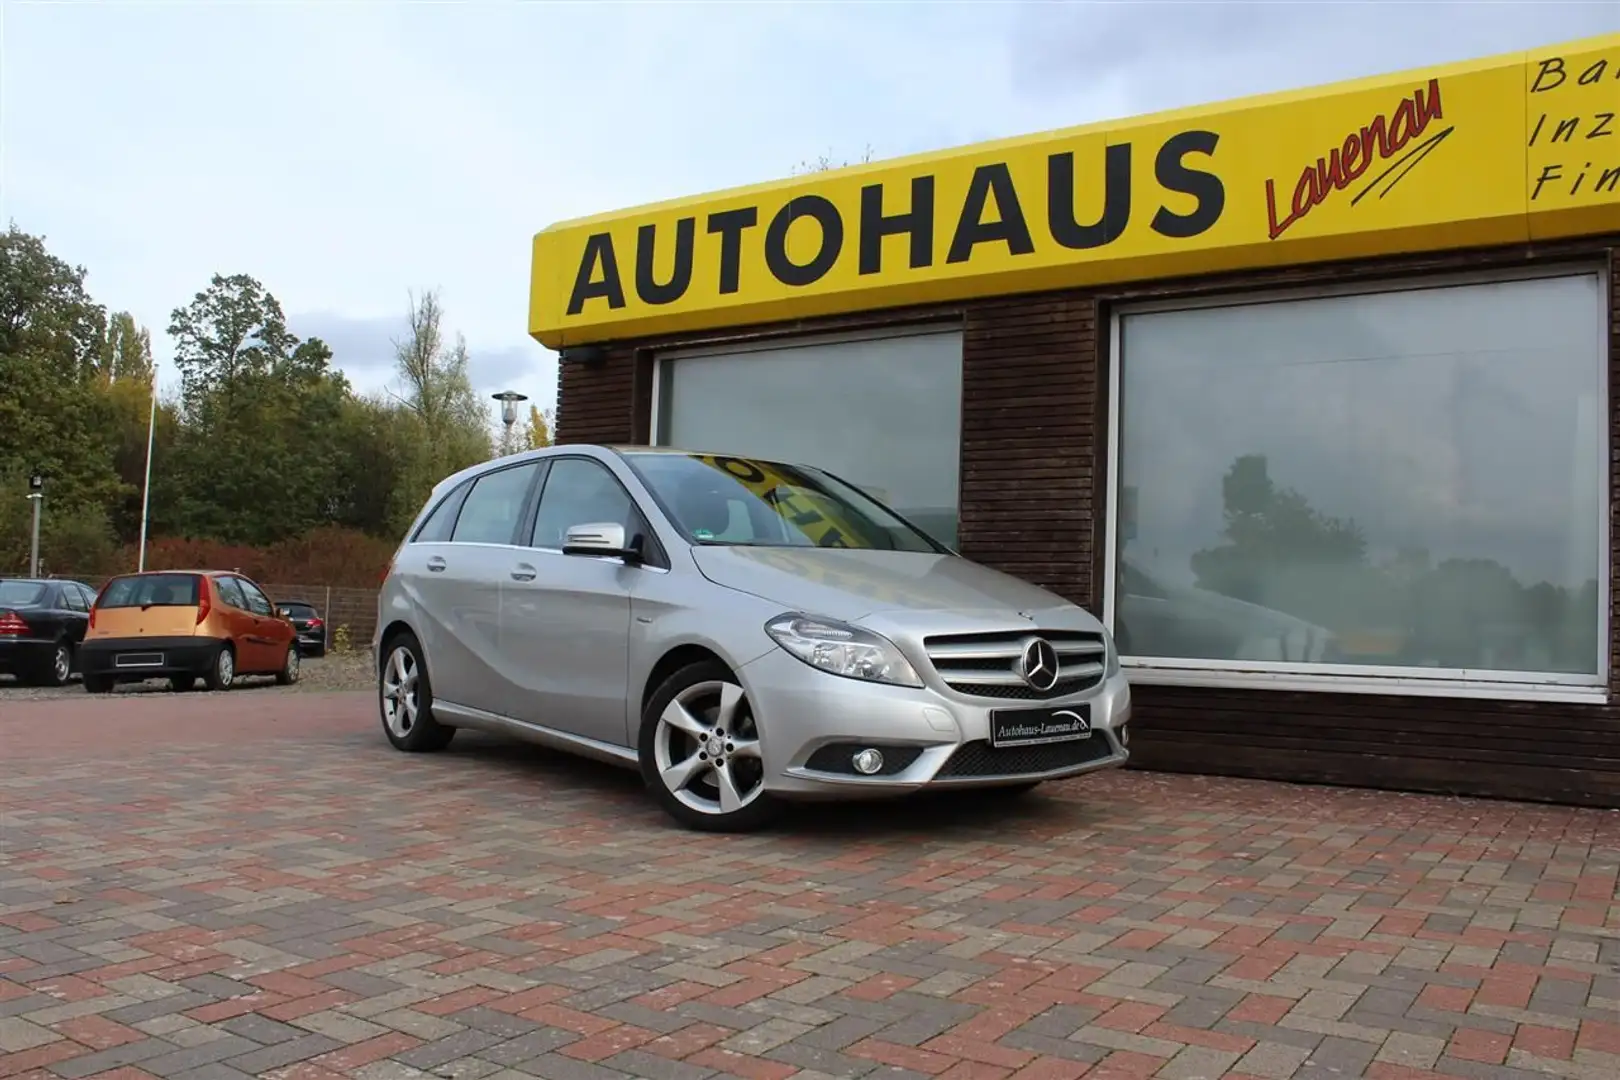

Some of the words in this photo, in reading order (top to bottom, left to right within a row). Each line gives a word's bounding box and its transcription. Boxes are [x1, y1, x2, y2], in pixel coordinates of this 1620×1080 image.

[1530, 57, 1620, 93] Ba
[565, 130, 1225, 315] AUTOHAUS
[1265, 78, 1443, 241] Lauenau
